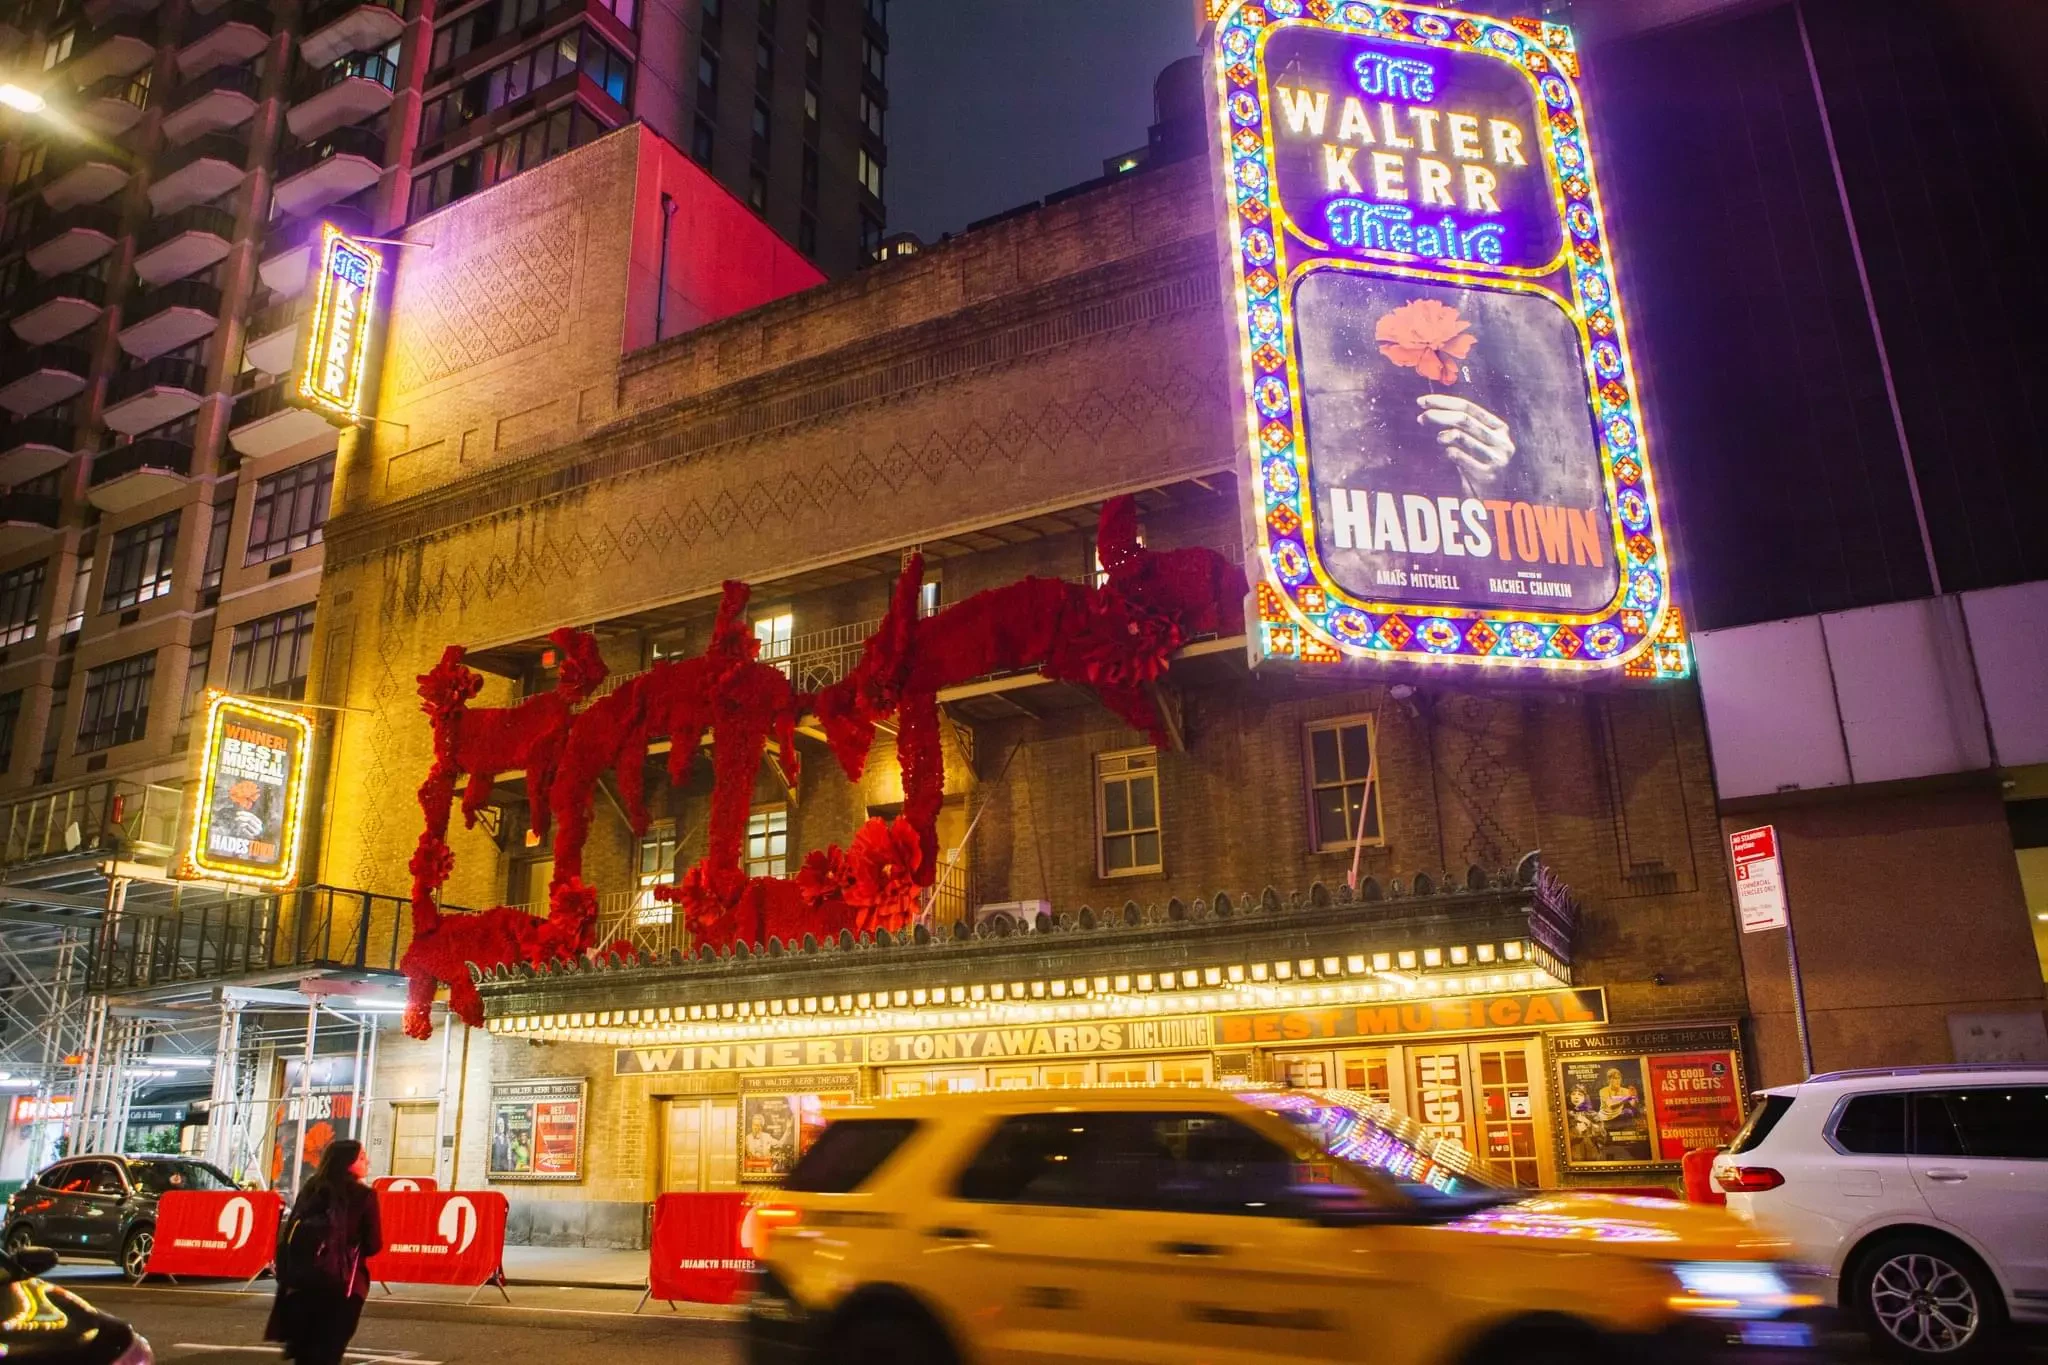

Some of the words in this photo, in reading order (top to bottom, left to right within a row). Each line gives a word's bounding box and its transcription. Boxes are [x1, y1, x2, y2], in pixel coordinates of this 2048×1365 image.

[1354, 52, 1435, 101] The
[1276, 86, 1527, 165] WALTER
[1323, 144, 1502, 212] KERR
[1325, 198, 1505, 265] Theatre
[333, 250, 368, 287] The
[323, 280, 358, 397] KERR
[1330, 487, 1603, 568] HADESTOWN
[1411, 573, 1460, 590] MITCHELL
[1488, 578, 1527, 594] RACHEL
[1530, 582, 1572, 597] CHAVKIN
[224, 724, 287, 752] WINNER!
[224, 737, 287, 764] BEST
[222, 751, 285, 778] MUSICAL
[210, 835, 276, 858] HADESTOWN
[1739, 867, 1747, 879] 3
[1222, 1011, 1342, 1043] BEST
[1356, 996, 1595, 1035] MUSICAL
[869, 1038, 890, 1062] 8
[894, 1033, 978, 1060] TONY
[1128, 1018, 1207, 1049] INCLUDING
[1557, 1038, 1581, 1049] THE
[1584, 1035, 1632, 1048] WALTER
[1636, 1033, 1669, 1046] KERR
[1673, 1030, 1729, 1043] THEATRE
[635, 1040, 852, 1072] WINNER!
[749, 1079, 761, 1087] THE
[765, 1078, 792, 1086] WALTER
[795, 1077, 814, 1085] KERR
[817, 1076, 850, 1084] THEATRE
[1661, 1080, 1676, 1091] AS
[1679, 1079, 1689, 1090] IT
[1667, 1070, 1678, 1079] AS
[1681, 1069, 1705, 1078] GOOD
[510, 1087, 532, 1095] WALTER
[534, 1086, 550, 1094] KERR
[288, 1094, 363, 1120] HDESTOW
[1662, 1128, 1719, 1138] EXQUISITELY
